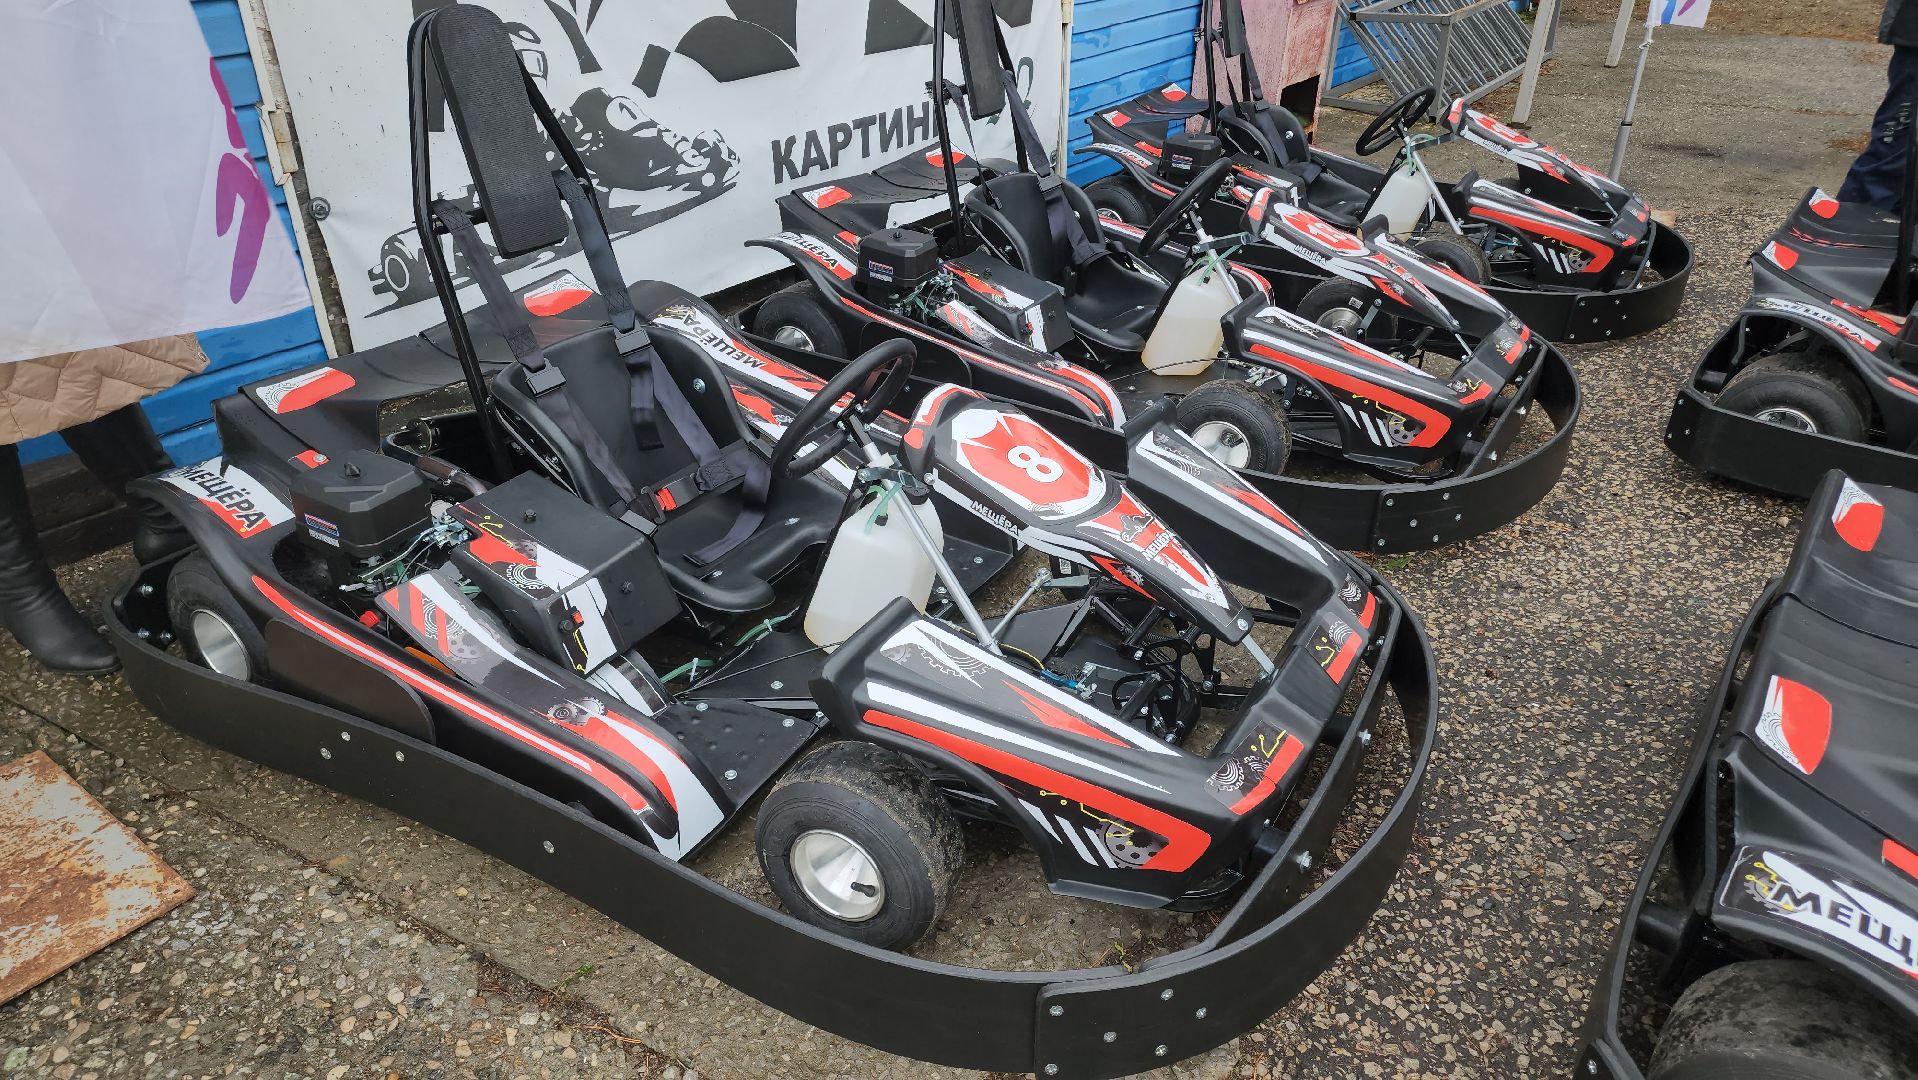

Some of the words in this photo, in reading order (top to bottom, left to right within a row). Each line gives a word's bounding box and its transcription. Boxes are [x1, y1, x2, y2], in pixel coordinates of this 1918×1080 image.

[683, 313, 763, 368] МЕЩЁРА
[1007, 445, 1063, 483] 8
[971, 500, 1019, 536] МЕЩЁРА
[1771, 882, 1918, 967] МЕЩ
